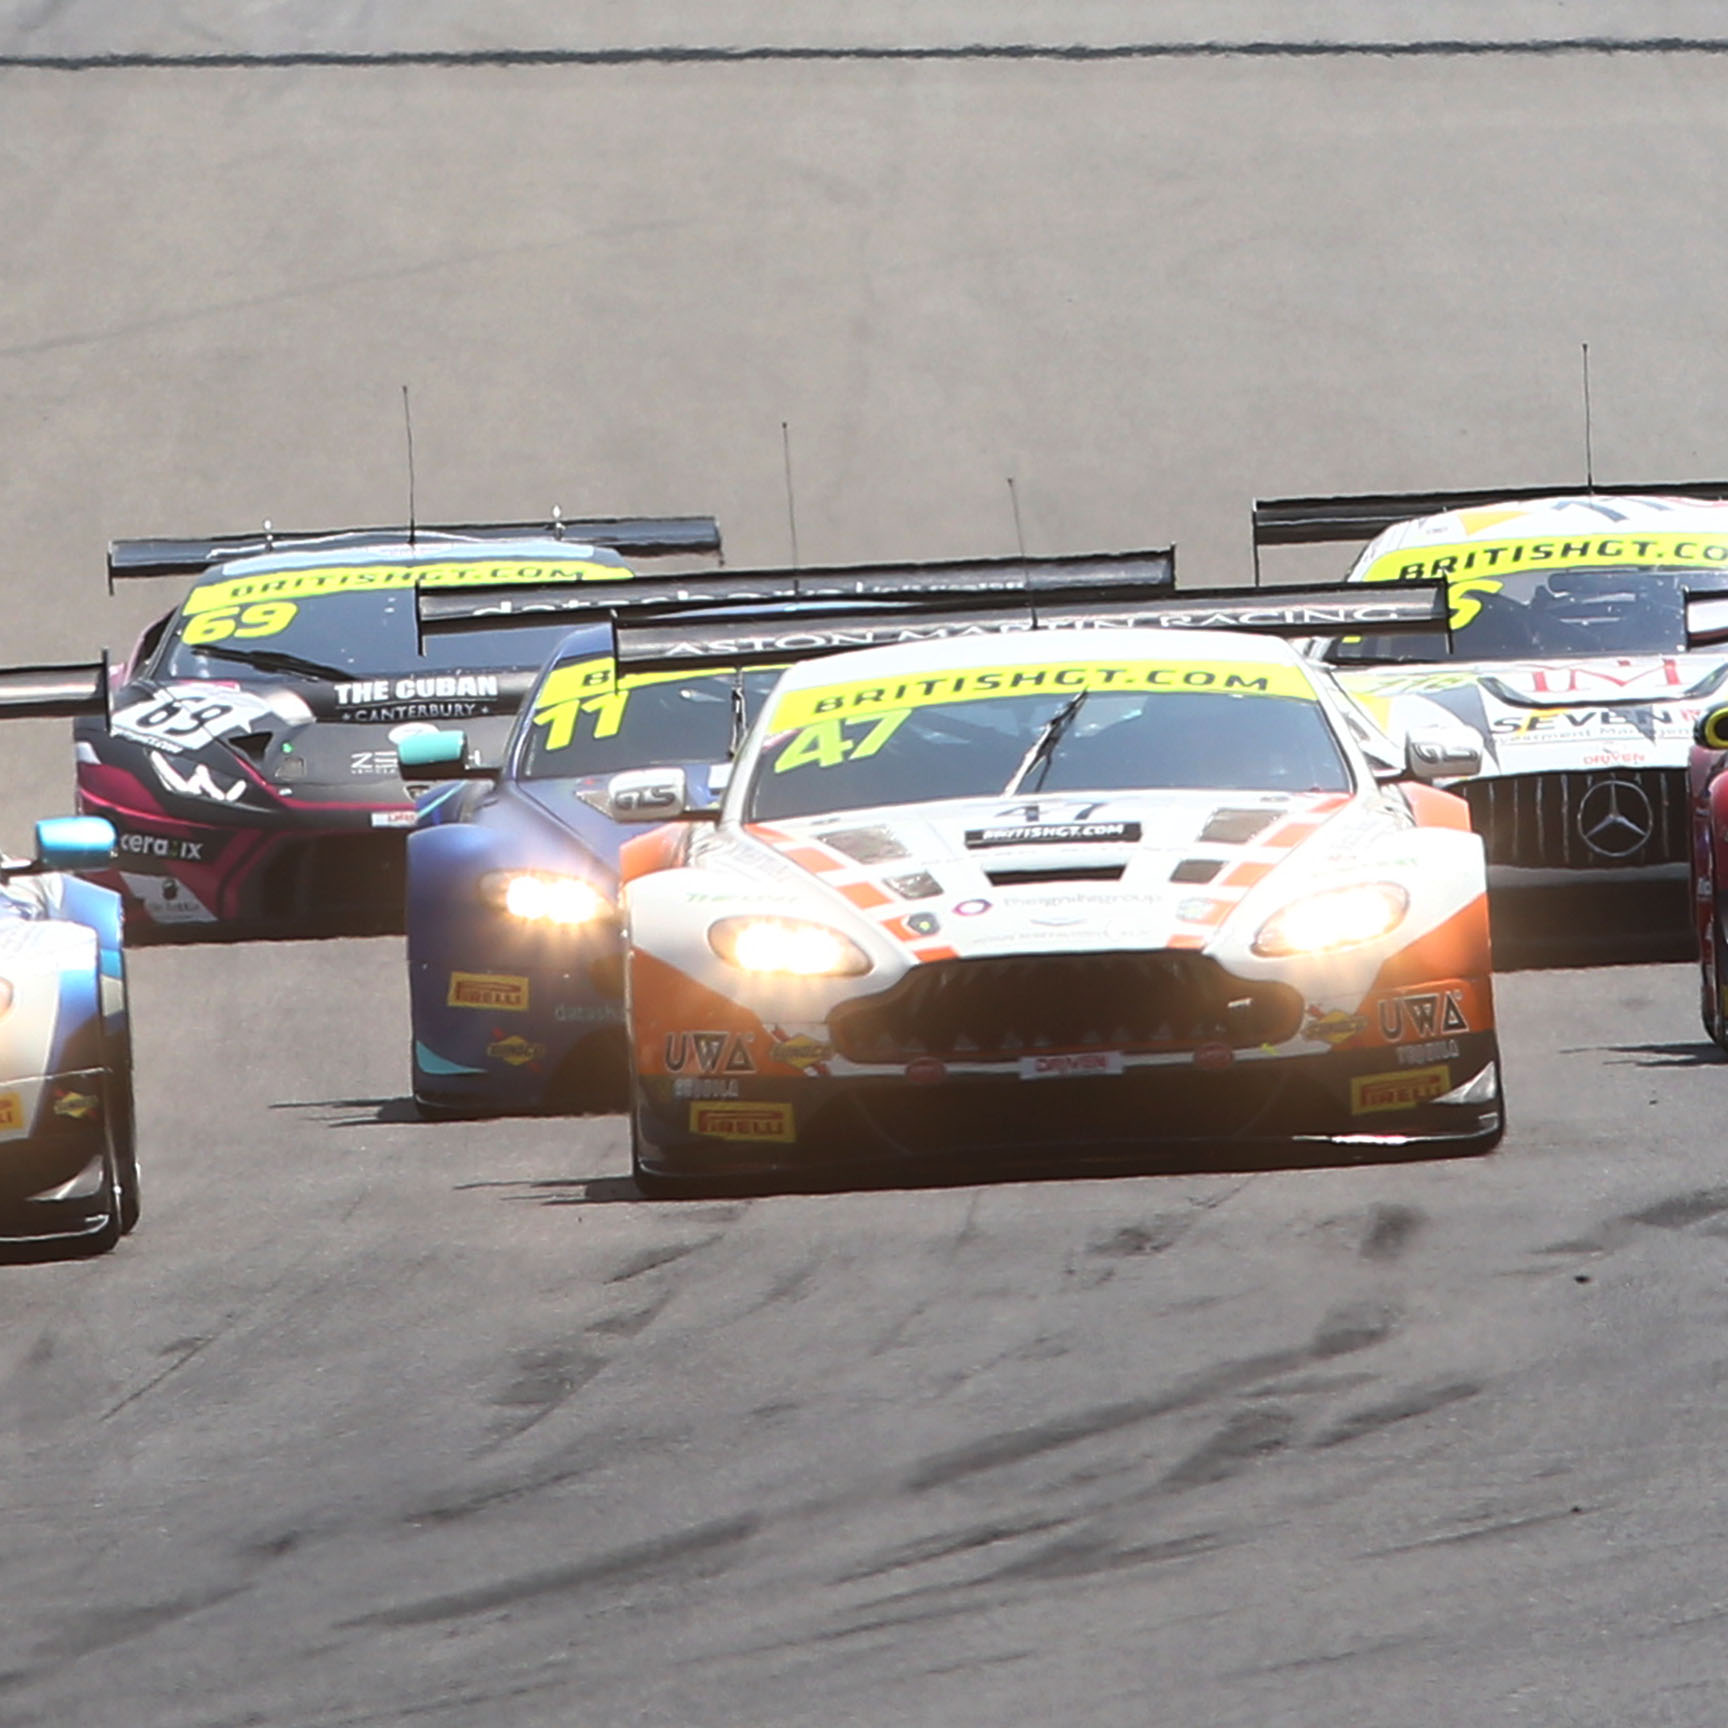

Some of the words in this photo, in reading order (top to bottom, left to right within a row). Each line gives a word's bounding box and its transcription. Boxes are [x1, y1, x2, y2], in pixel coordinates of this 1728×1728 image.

[181, 601, 300, 646] 69
[665, 629, 874, 657] ASTON
[1160, 605, 1398, 628] RACING
[335, 683, 389, 703] THE
[396, 676, 499, 700] CUBAN
[814, 667, 1269, 714] BRITISHGT.COM
[135, 696, 233, 736] 69
[355, 702, 477, 722] CANTERBURY
[534, 690, 629, 752] 11
[773, 708, 913, 774] 47
[993, 802, 1109, 822] 47
[456, 980, 522, 1006] PIRELLI
[698, 1108, 784, 1135] PIRELLI
